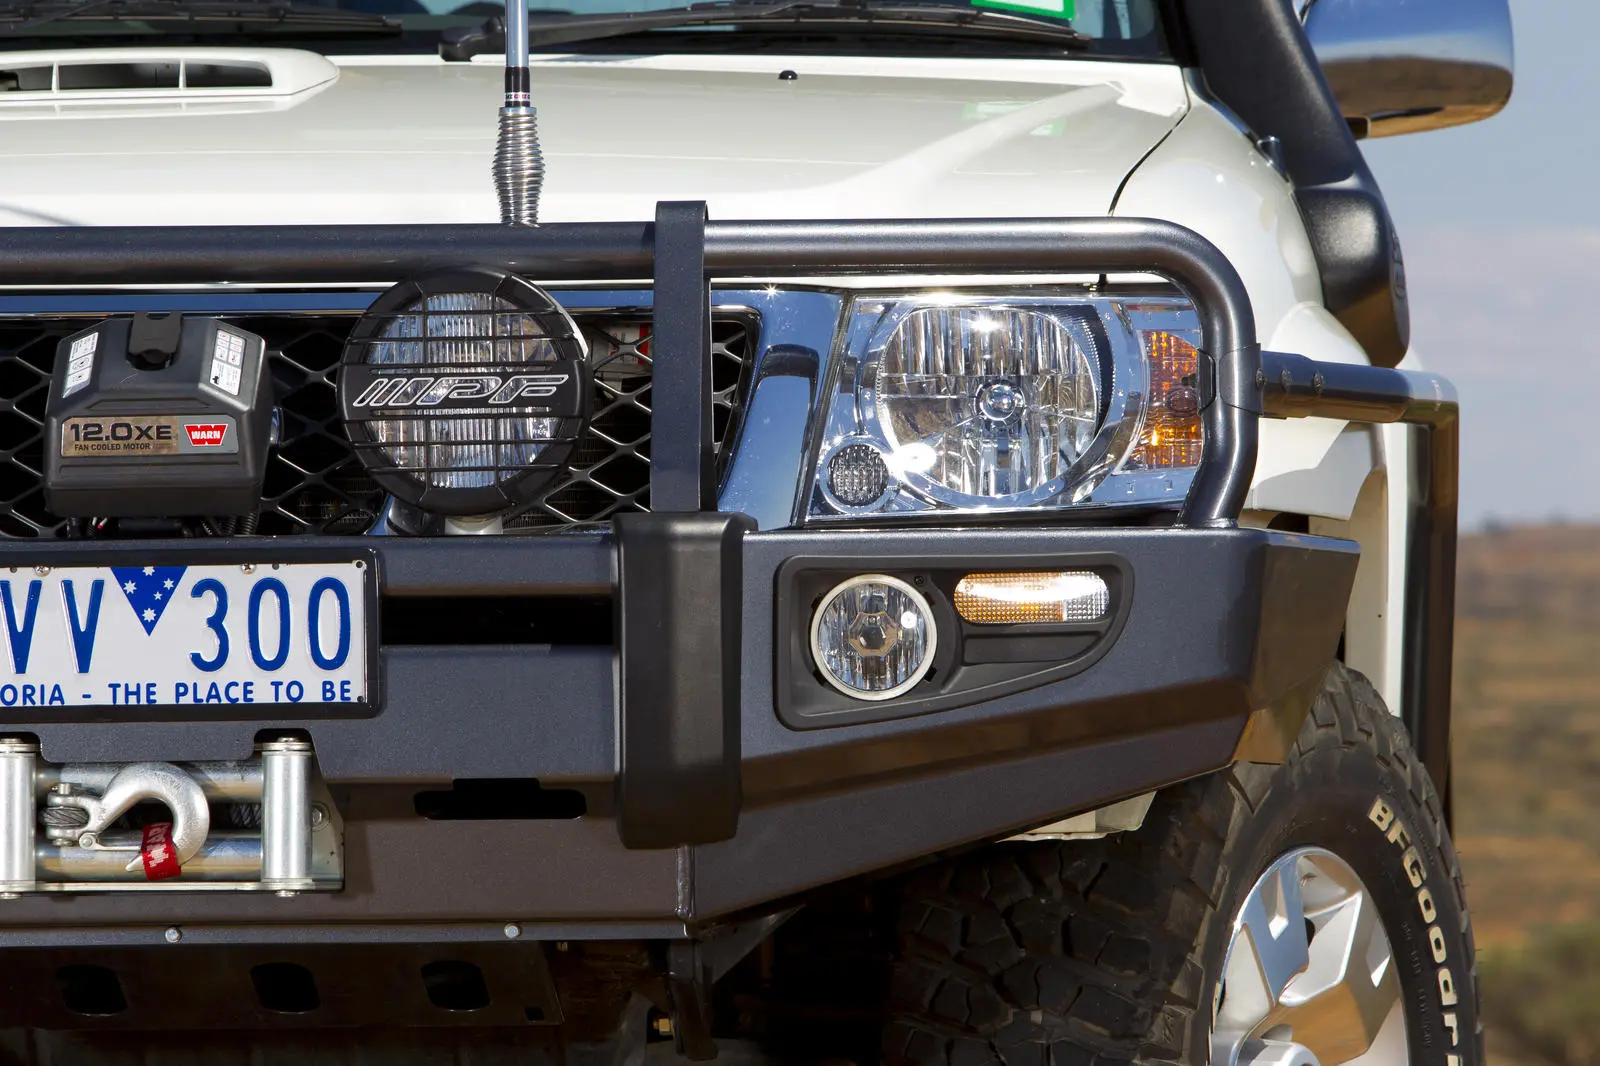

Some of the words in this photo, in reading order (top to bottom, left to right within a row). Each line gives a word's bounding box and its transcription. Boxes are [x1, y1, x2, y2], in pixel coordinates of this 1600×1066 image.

[191, 430, 221, 440] WARN
[91, 443, 121, 451] COOLED
[123, 442, 150, 450] MOTOR
[190, 577, 351, 672] 300
[108, 683, 157, 705] THE
[175, 681, 254, 704] PLACE
[270, 681, 304, 703] TO
[321, 680, 351, 702] BE
